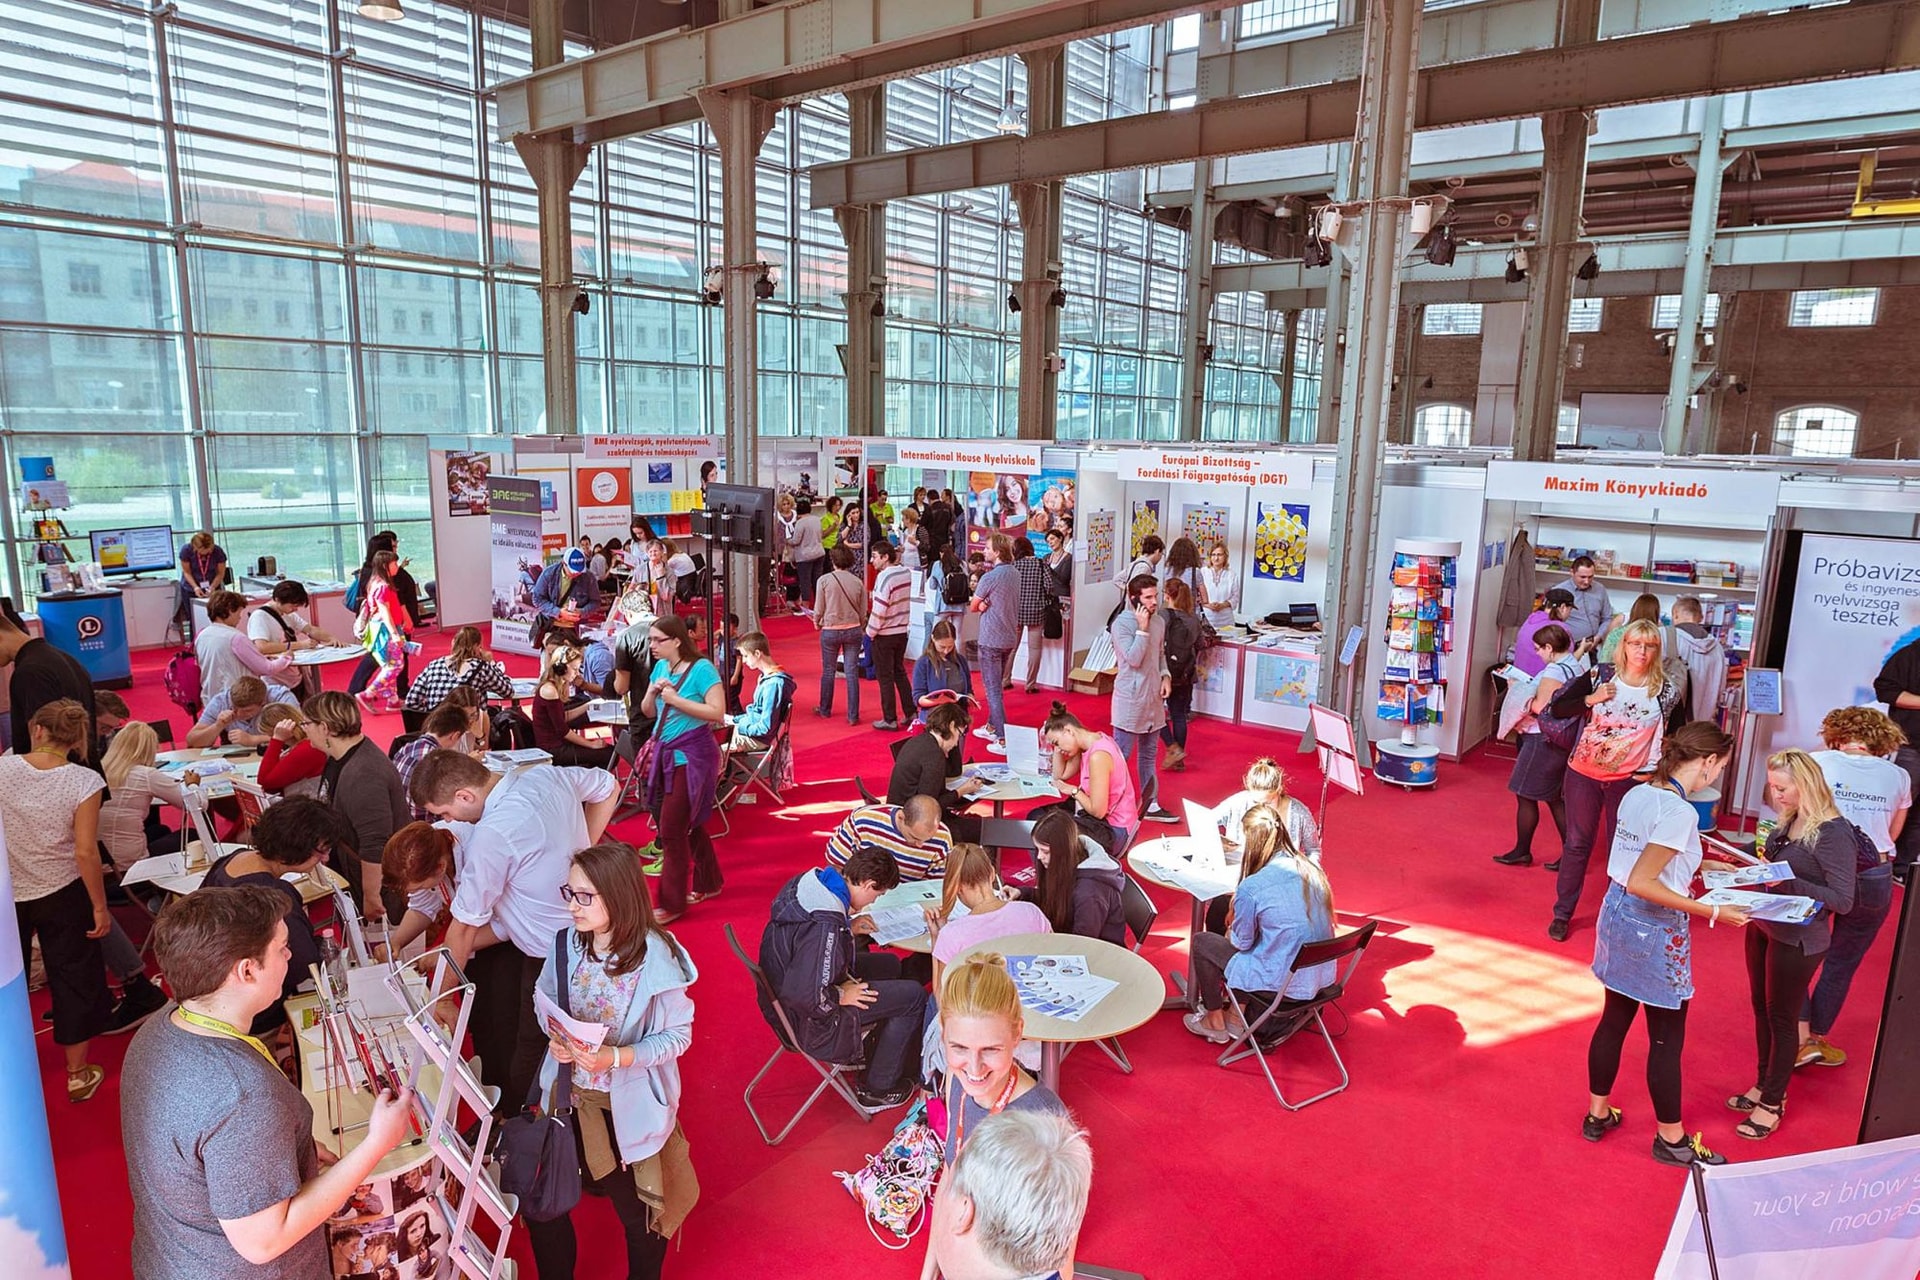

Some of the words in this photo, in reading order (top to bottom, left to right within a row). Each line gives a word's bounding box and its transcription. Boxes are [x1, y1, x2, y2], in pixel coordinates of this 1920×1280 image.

[594, 437, 608, 445] BME
[901, 450, 953, 462] International
[956, 452, 981, 463] House
[984, 454, 1036, 466] Nyelviskola
[1162, 454, 1199, 467] Európai
[1203, 456, 1251, 470] Bizottság
[1138, 468, 1180, 479] Fordítási
[1183, 470, 1256, 485] Főigazgatóság
[1259, 473, 1288, 485] (DGT)
[1544, 476, 1599, 492] Maxim
[1605, 479, 1708, 498] Könyvkiadó
[491, 522, 507, 535] BME
[1844, 581, 1858, 592] és
[1814, 593, 1900, 612] nyelvvizsga
[1832, 608, 1900, 627] tesztek
[1835, 789, 1887, 803] euroexam
